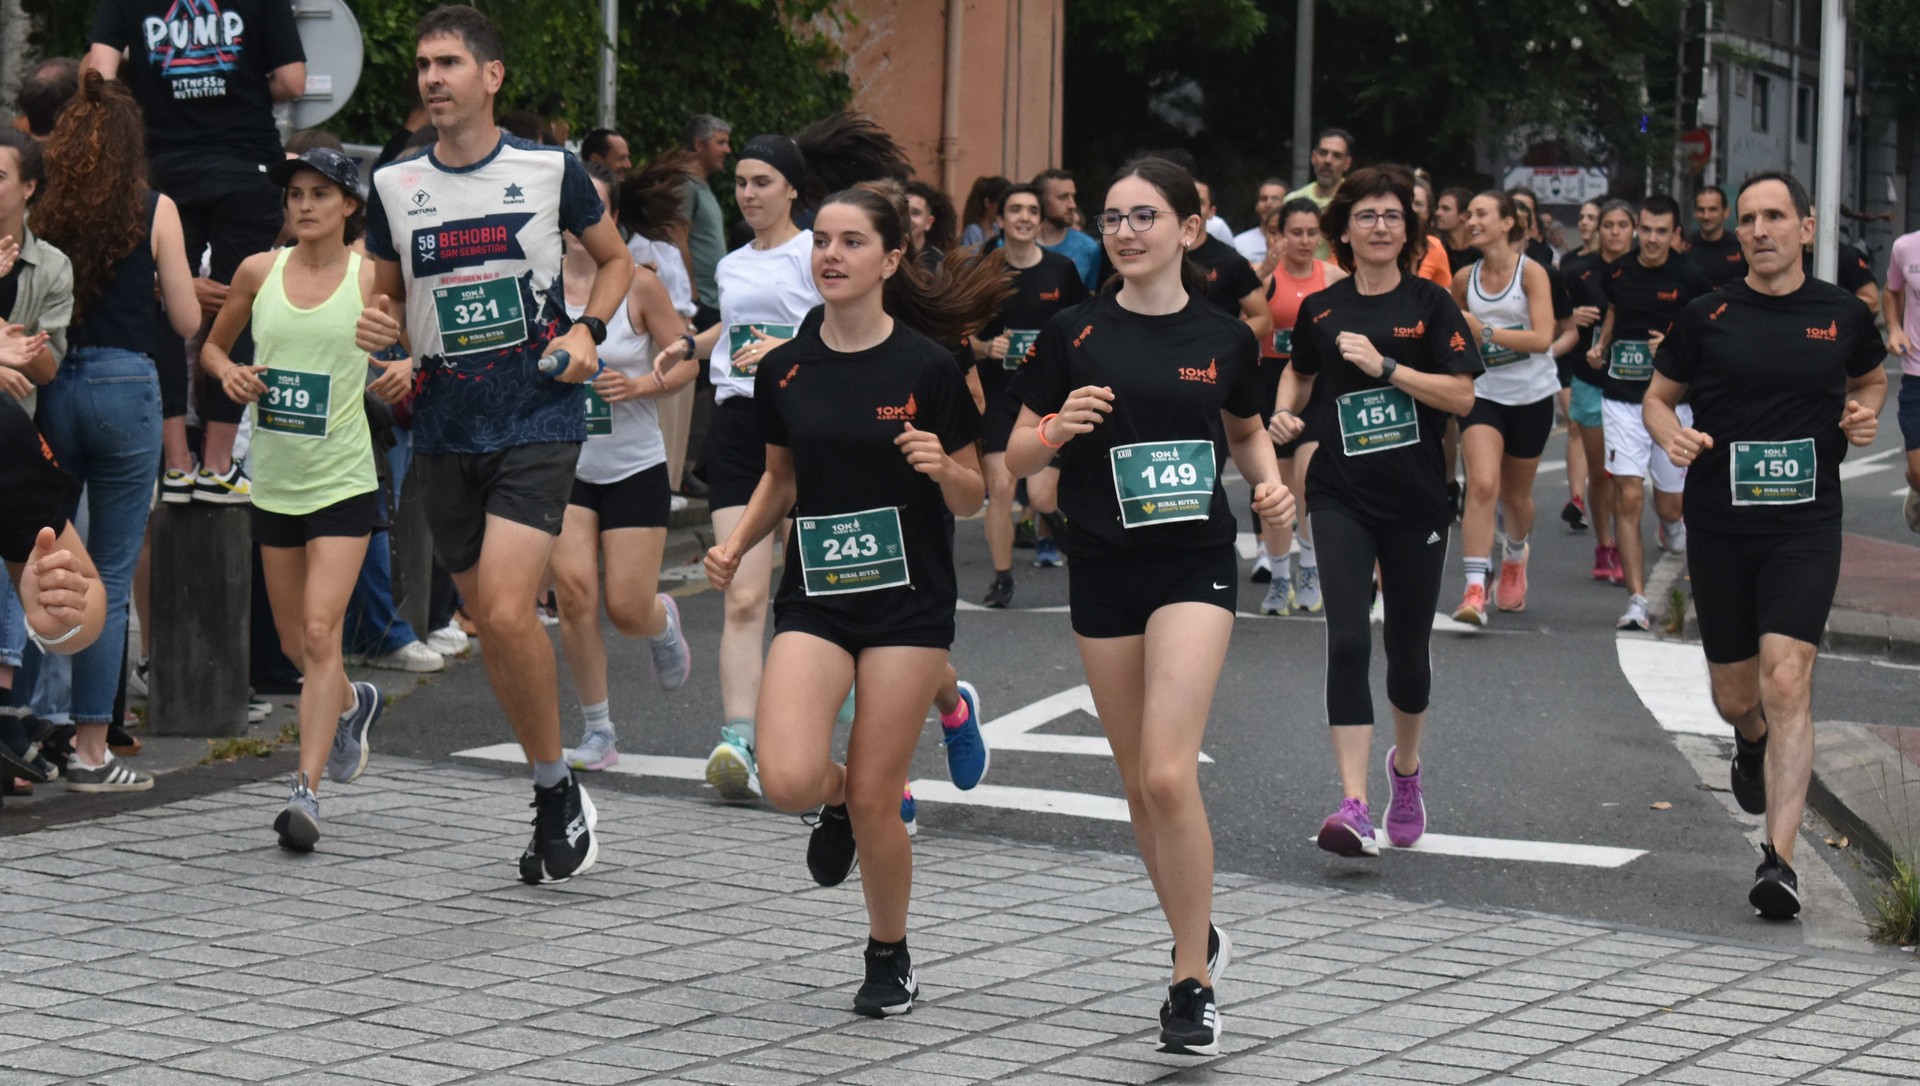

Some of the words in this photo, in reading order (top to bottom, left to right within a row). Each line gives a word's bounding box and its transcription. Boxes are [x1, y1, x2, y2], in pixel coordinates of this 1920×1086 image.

[144, 10, 244, 52] PUMP
[418, 234, 436, 251] 58
[439, 225, 508, 248] BEHOBIA
[440, 248, 459, 259] SAN
[459, 243, 508, 257] SEBASTIAN
[454, 299, 499, 325] 321
[1620, 351, 1644, 364] 270
[1178, 368, 1207, 377] 10K
[268, 386, 310, 408] 319
[876, 406, 905, 415] 10K
[1357, 404, 1397, 426] 151
[1117, 448, 1132, 459] XXIII
[1141, 463, 1197, 488] 149
[1754, 459, 1799, 477] 150
[832, 523, 852, 531] 10K
[822, 534, 878, 561] 243
